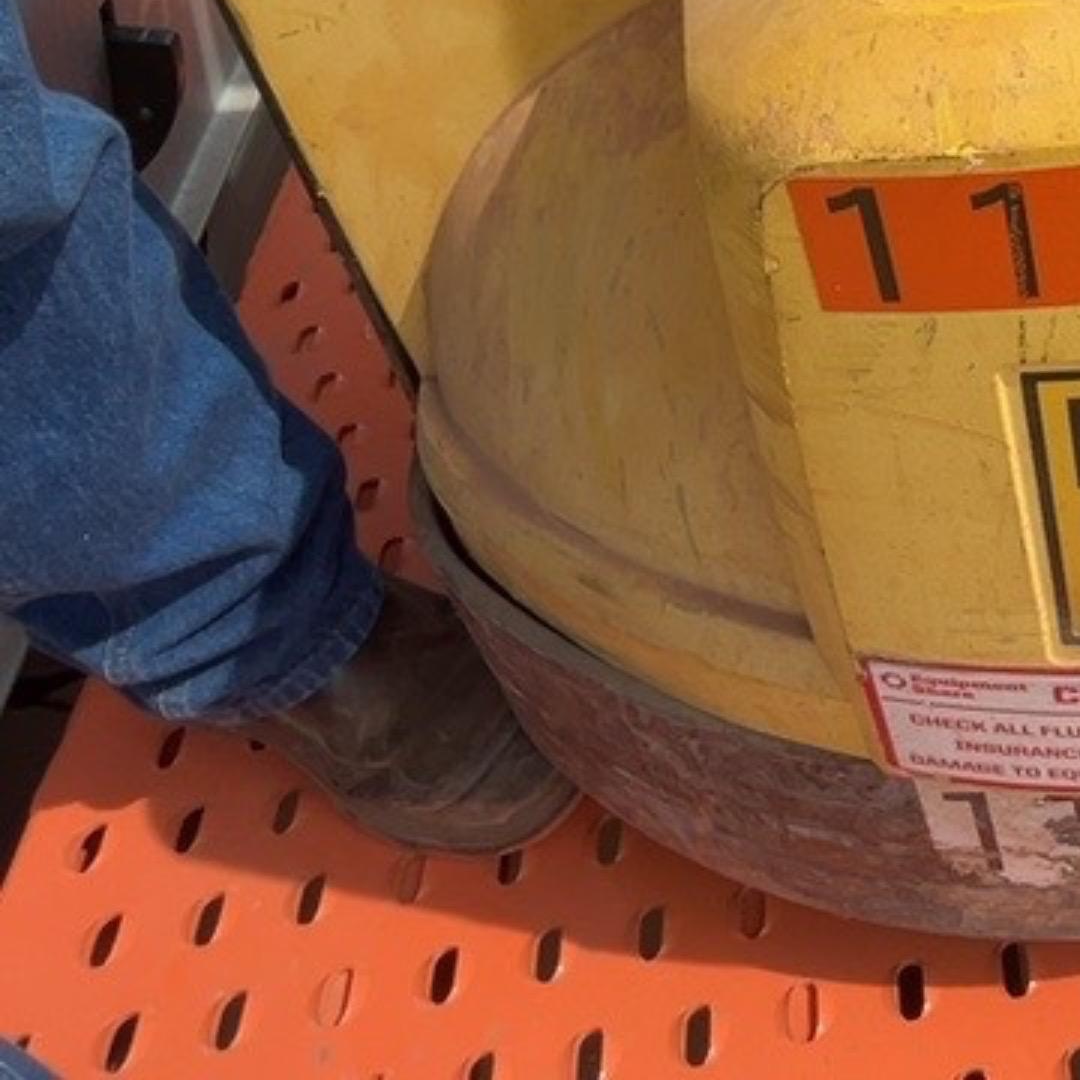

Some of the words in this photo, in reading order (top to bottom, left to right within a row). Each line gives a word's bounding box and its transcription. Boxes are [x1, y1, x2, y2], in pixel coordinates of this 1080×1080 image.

[908, 713, 987, 733] CHECK
[993, 721, 1032, 736] ALL
[908, 753, 1006, 776] DAMAGE
[1012, 764, 1043, 778] TO
